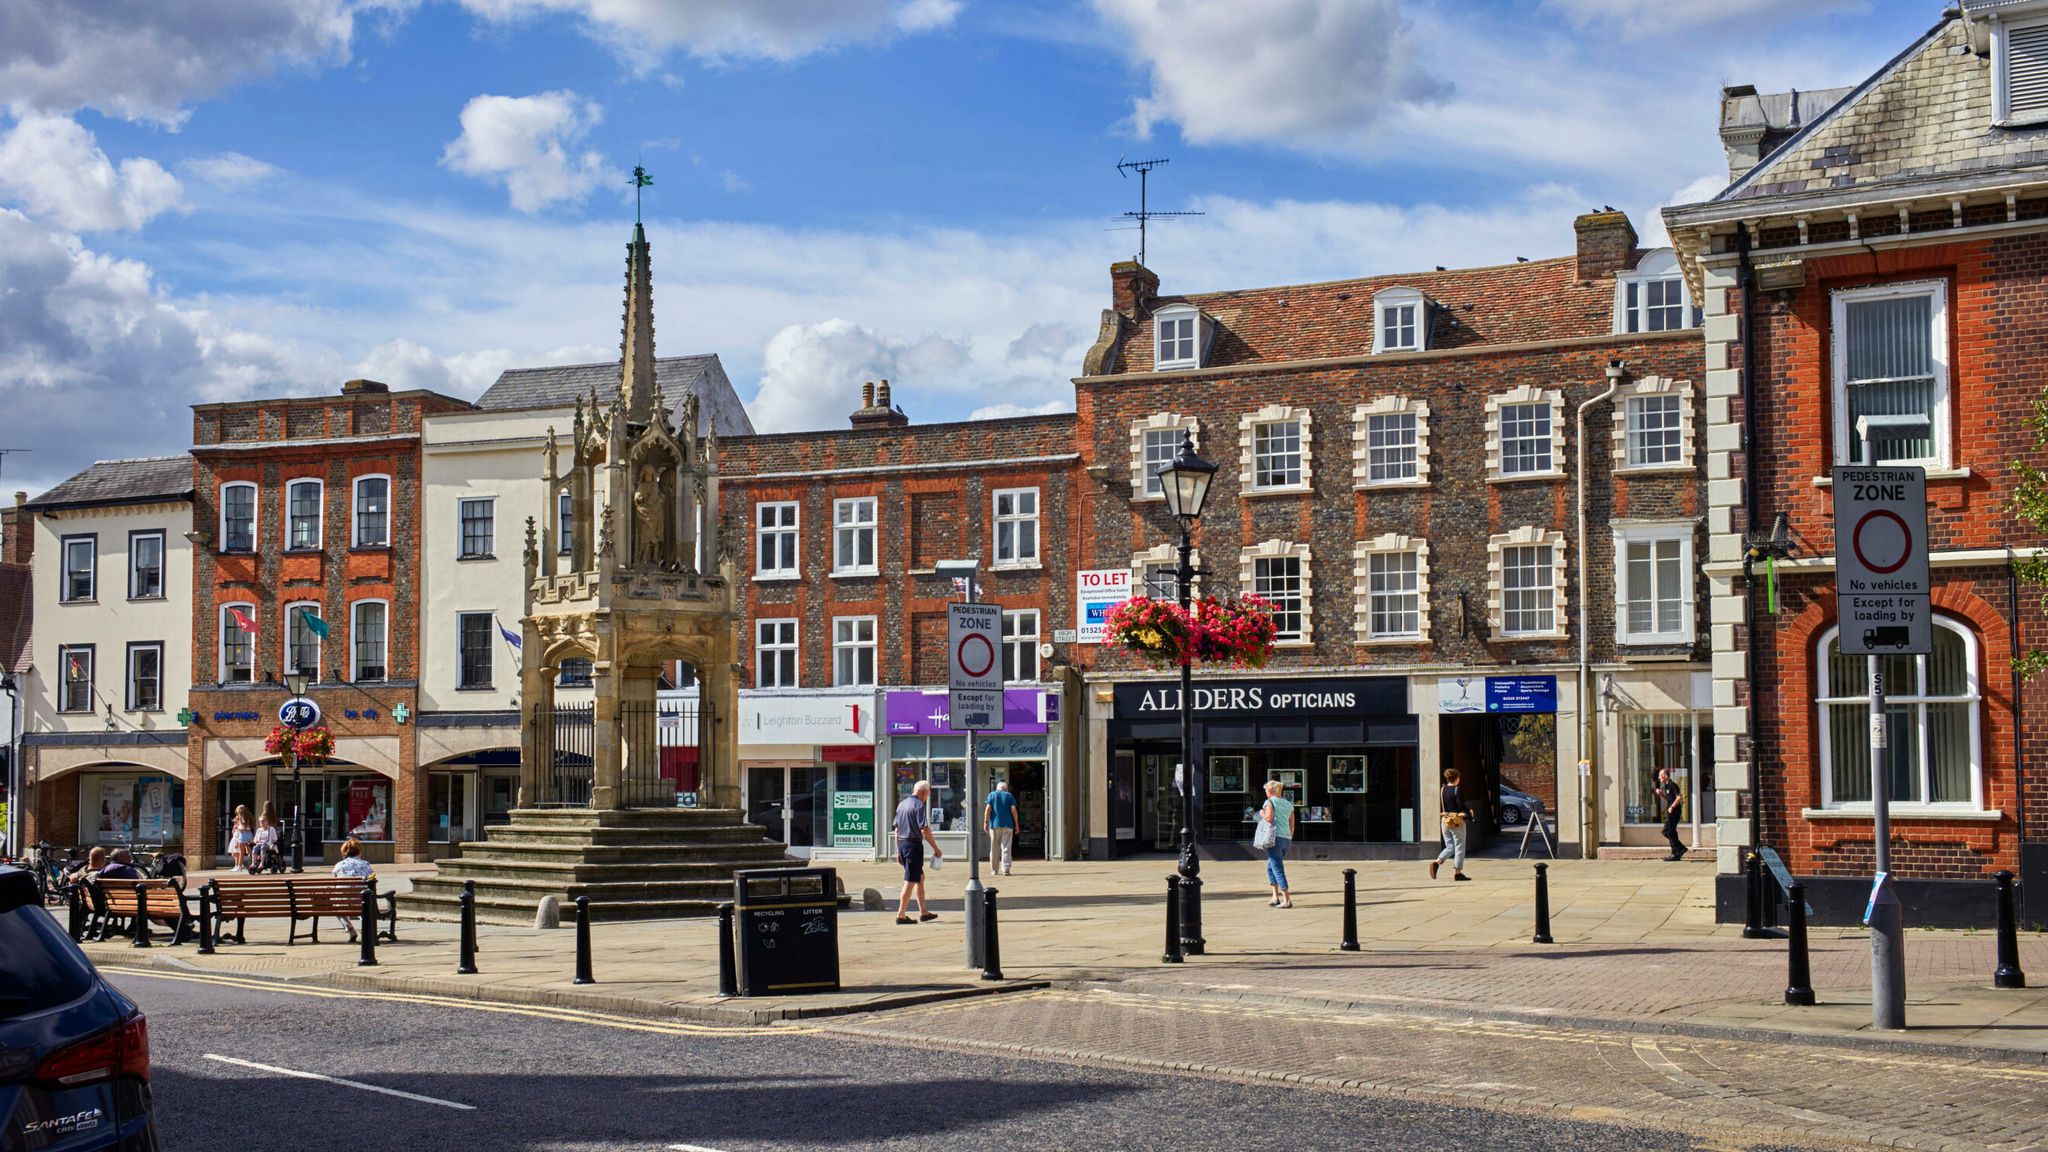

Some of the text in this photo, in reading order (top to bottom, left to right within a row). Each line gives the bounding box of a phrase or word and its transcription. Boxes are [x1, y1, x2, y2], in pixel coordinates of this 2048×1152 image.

[1842, 471, 1915, 482] PEDESTRIAN
[1853, 485, 1906, 501] ZONE
[1081, 573, 1128, 586] TO LET
[1850, 580, 1918, 590] No vehicles
[1853, 597, 1915, 609] Except for
[953, 606, 997, 615] PEDESTRIAN
[1854, 611, 1915, 622] loading by
[960, 617, 992, 629] ZONE
[958, 694, 983, 703] Except
[1270, 693, 1356, 708] OPTICIANS
[958, 703, 995, 711] loading by
[284, 706, 310, 722] Bots
[763, 715, 804, 727] Leighton
[805, 715, 841, 726] Buzzard
[1008, 739, 1043, 754] Cards
[1627, 806, 1645, 815] NHS
[846, 813, 860, 821] TO
[838, 822, 868, 831] LEASE
